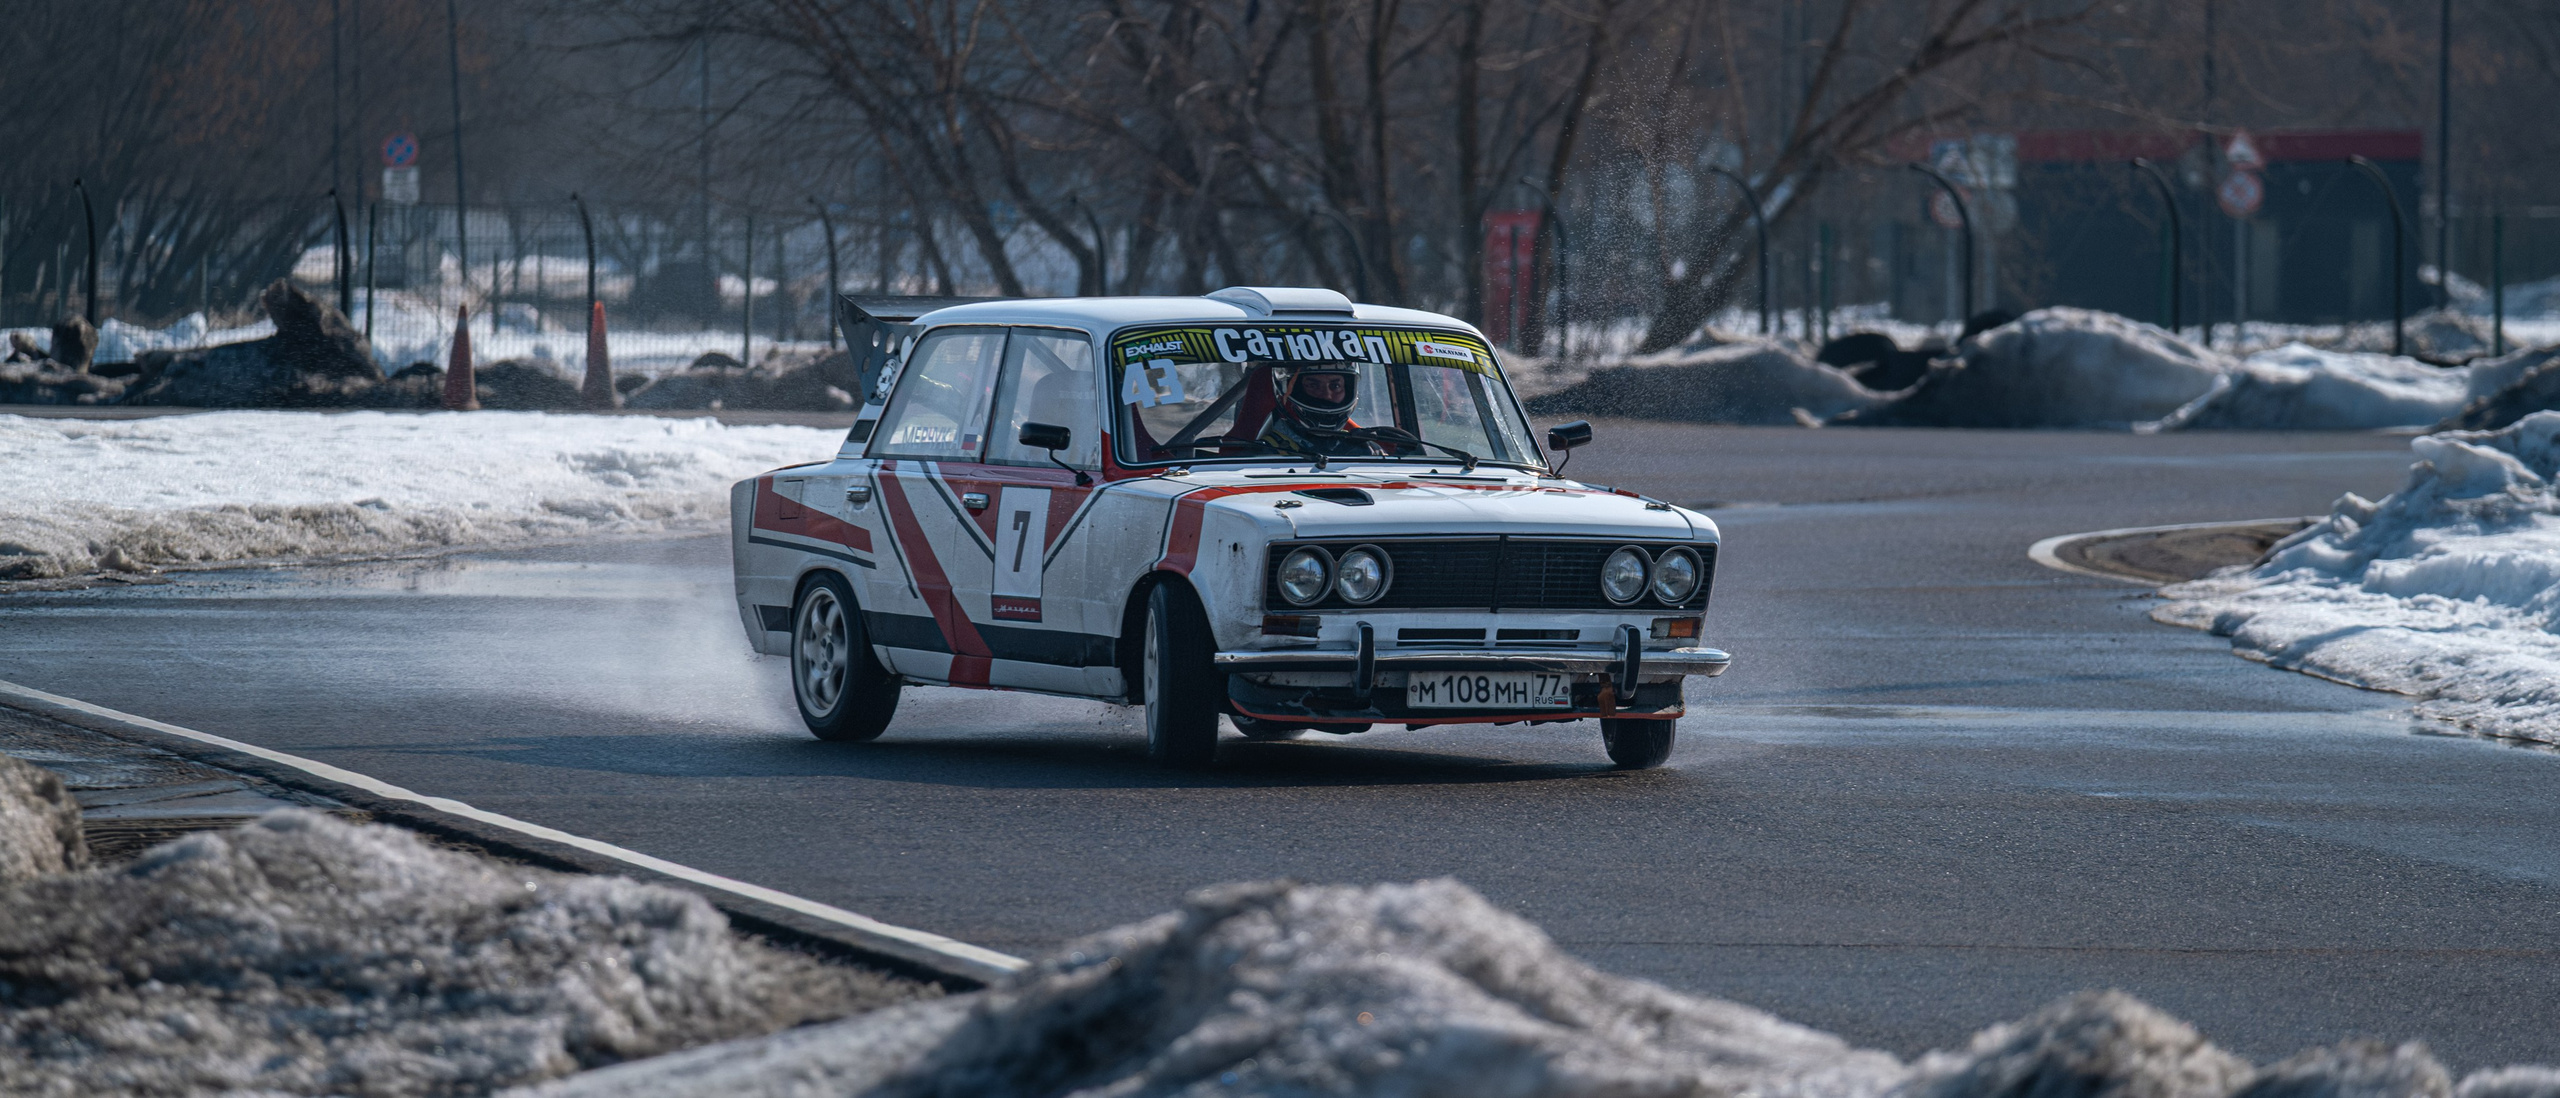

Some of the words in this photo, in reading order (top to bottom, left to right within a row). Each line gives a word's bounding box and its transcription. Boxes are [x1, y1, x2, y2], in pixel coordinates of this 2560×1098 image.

[1125, 341, 1183, 358] EXHAUST
[1434, 347, 1468, 358] TAKAYAMA
[1121, 358, 1185, 409] 43
[1013, 510, 1031, 572] 7
[1535, 674, 1562, 696] 77
[1534, 697, 1554, 705] RUS
